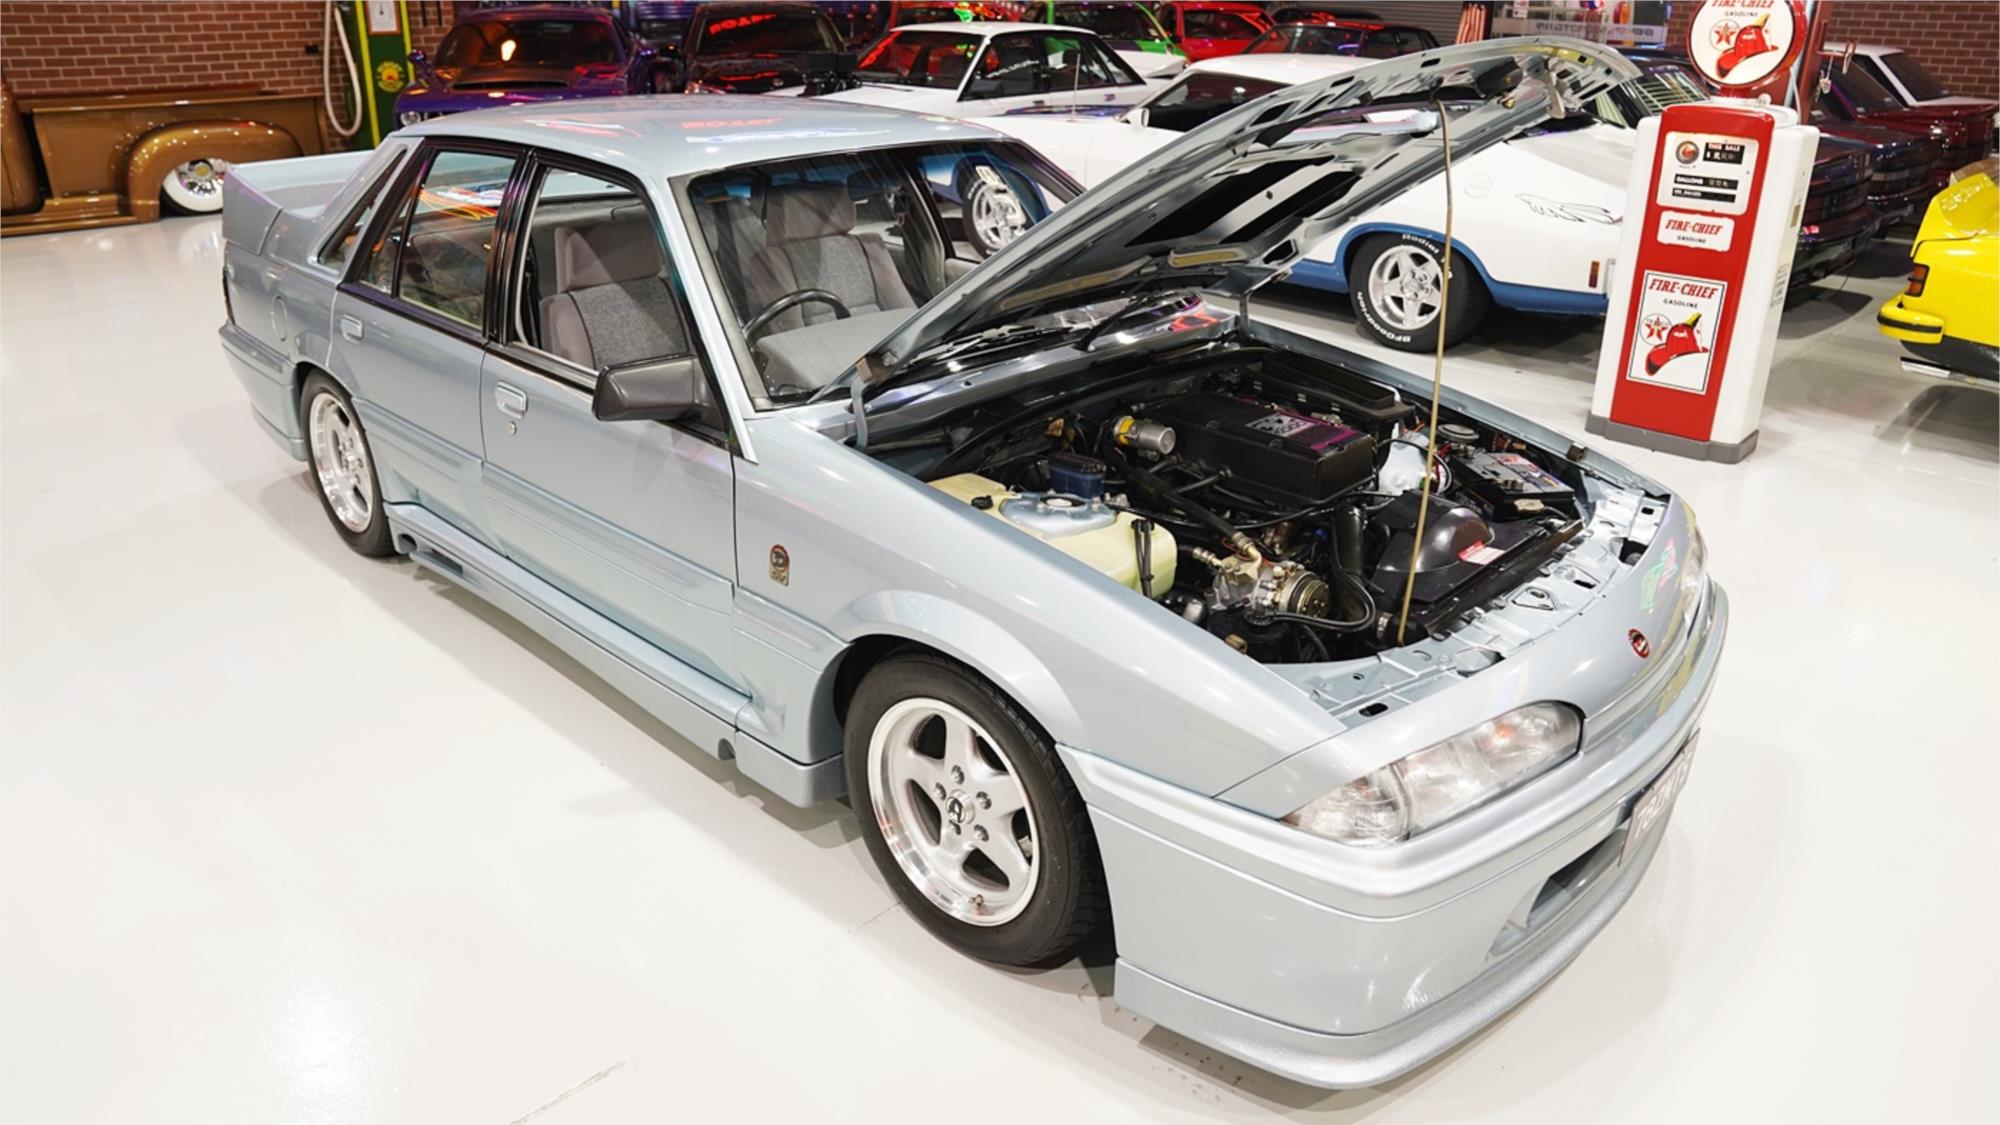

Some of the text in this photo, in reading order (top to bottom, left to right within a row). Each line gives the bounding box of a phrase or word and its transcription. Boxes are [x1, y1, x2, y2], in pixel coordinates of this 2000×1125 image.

[1665, 219, 1723, 235] FIRE-CHIEF
[1402, 233, 1440, 254] Radial
[1648, 278, 1719, 299] FIRE-CHIEF
[1664, 298, 1698, 308] GASOLINE
